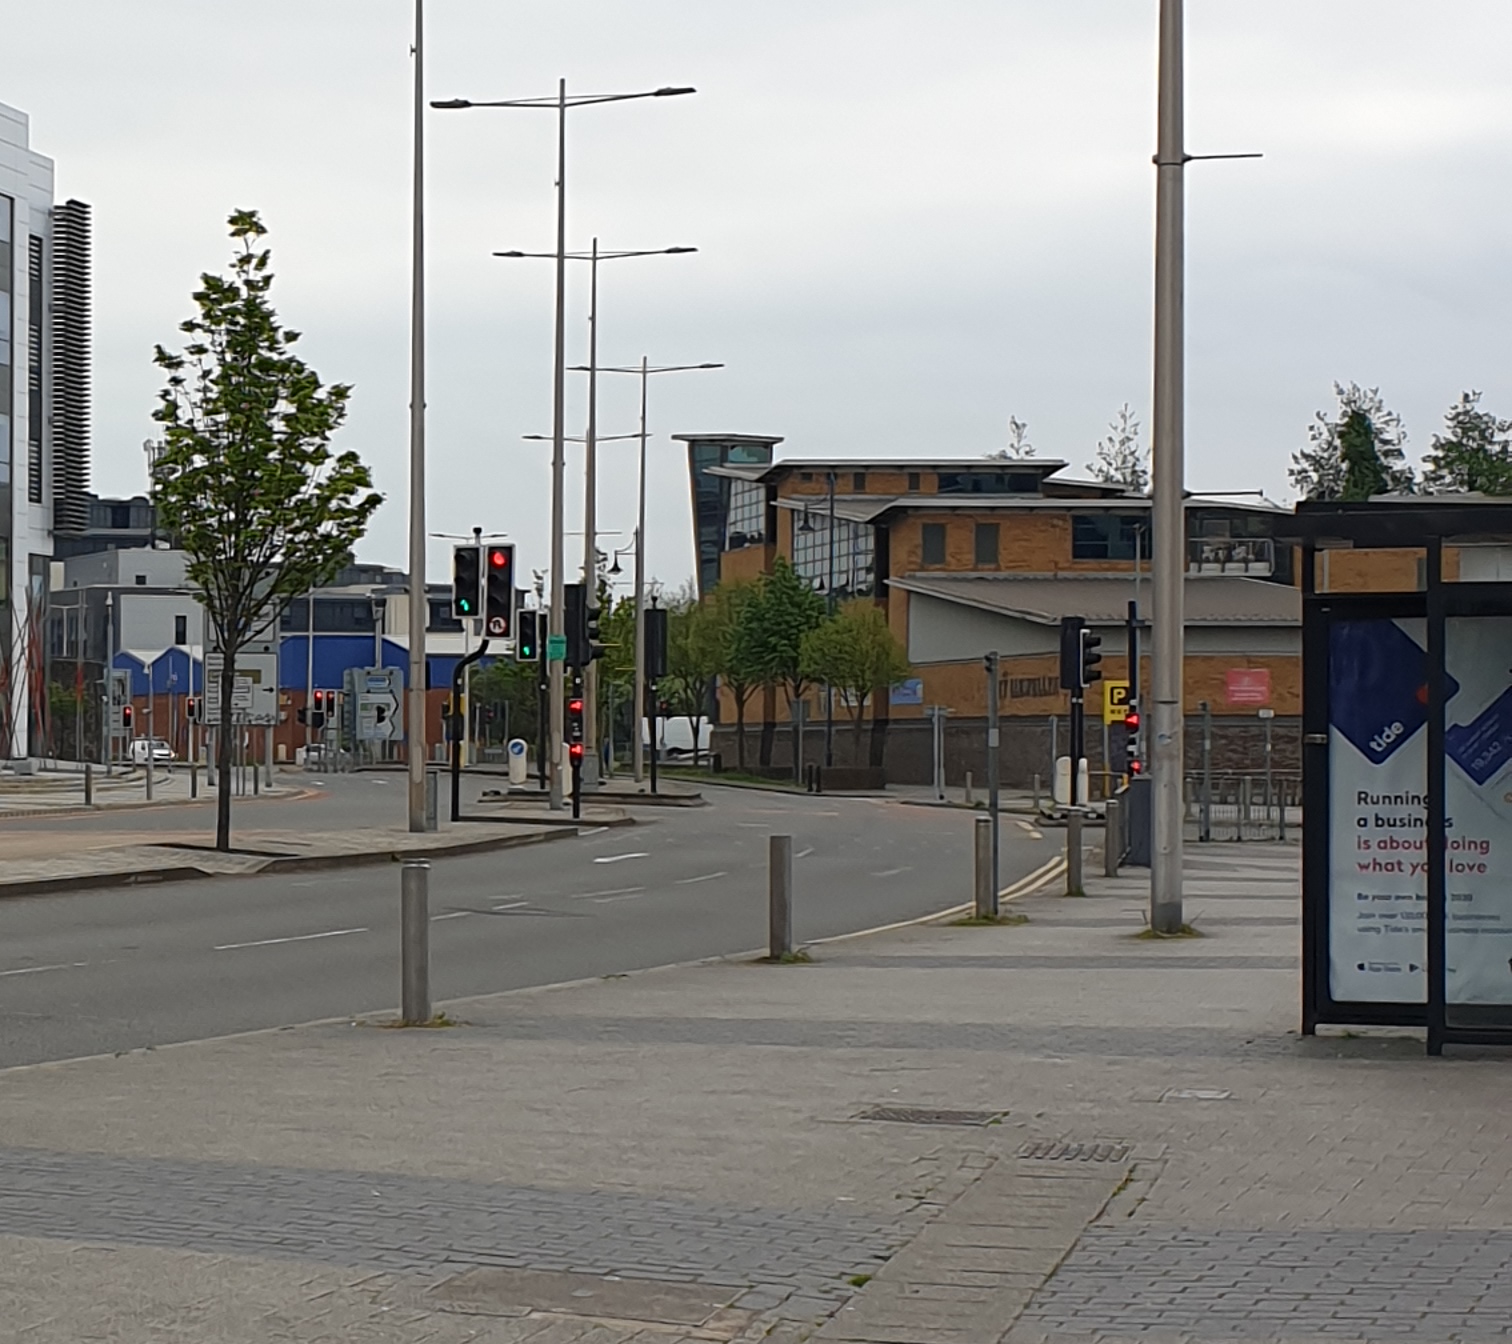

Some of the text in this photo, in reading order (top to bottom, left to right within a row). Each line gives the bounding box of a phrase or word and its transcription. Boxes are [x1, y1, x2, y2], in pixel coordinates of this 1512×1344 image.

[1112, 688, 1126, 704] P
[1356, 813, 1454, 828] a busins
[1357, 835, 1371, 850] is
[1357, 858, 1487, 876] what yo love
